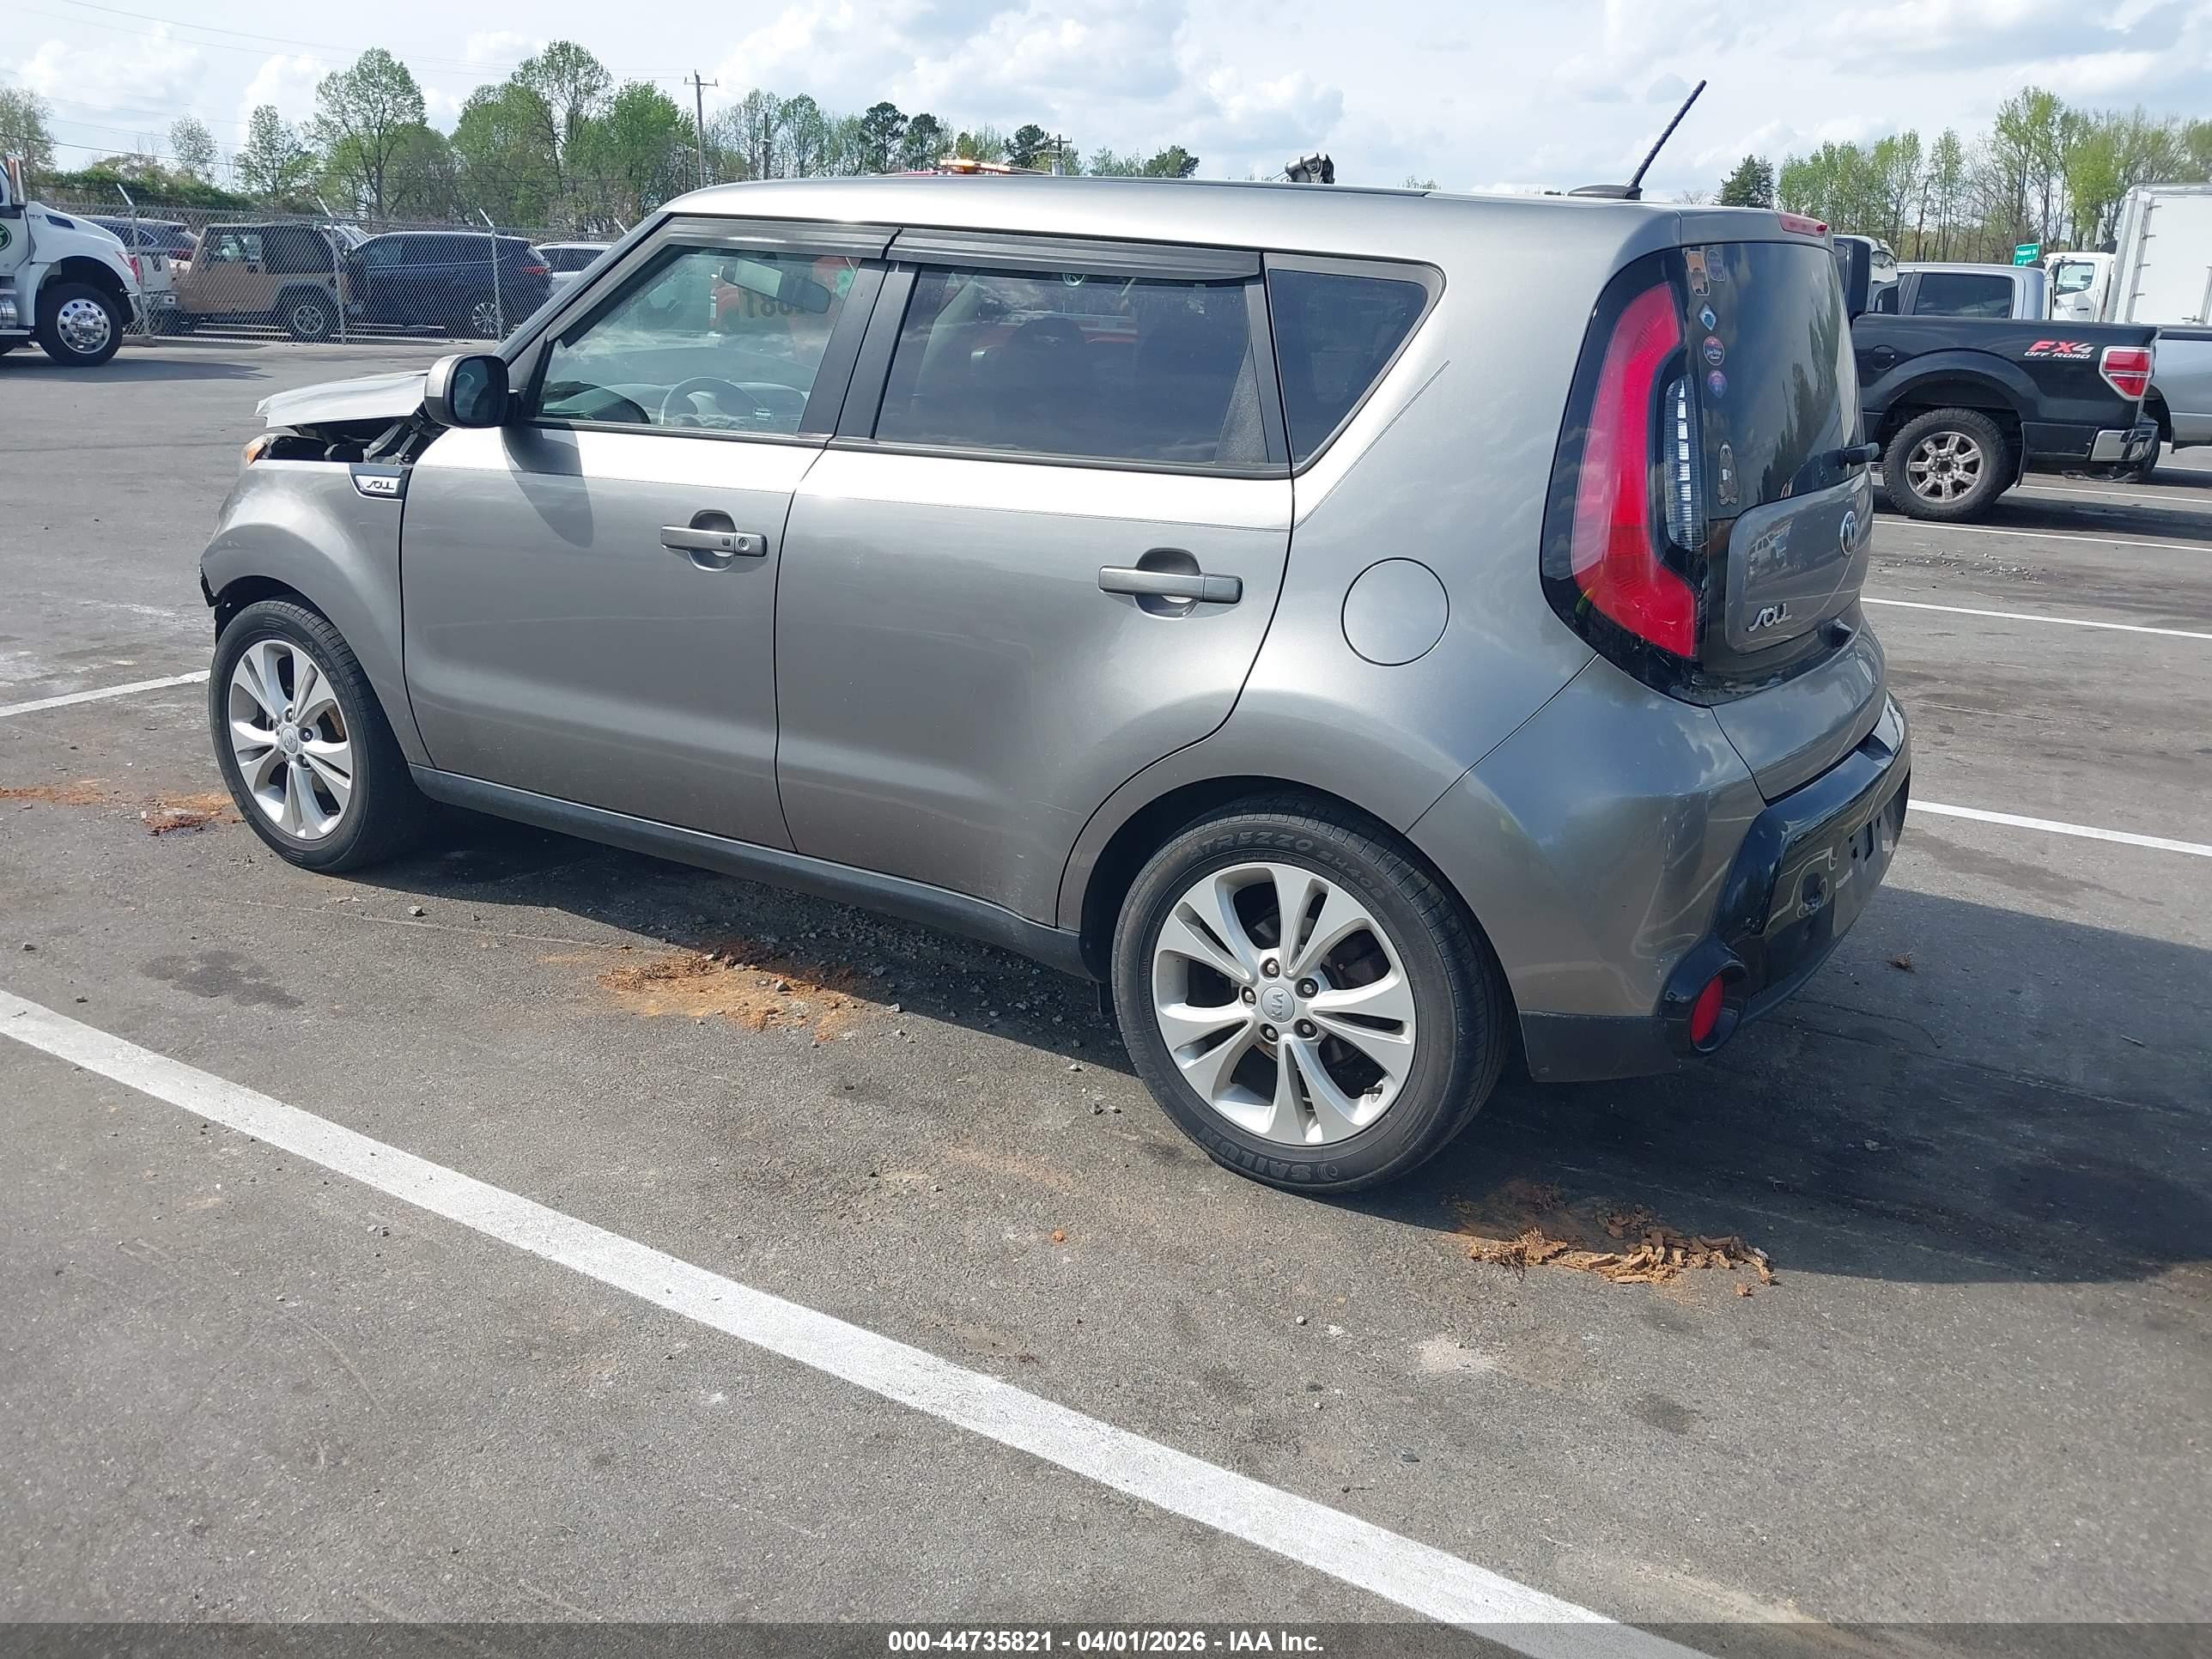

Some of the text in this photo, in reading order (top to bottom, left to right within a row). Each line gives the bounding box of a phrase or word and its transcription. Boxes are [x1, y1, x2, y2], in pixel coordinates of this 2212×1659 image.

[2028, 341, 2094, 354] FX4
[1188, 831, 1315, 862] ATREZZO
[1271, 992, 1284, 1021] KIA
[1197, 1126, 1312, 1182] SAILUN
